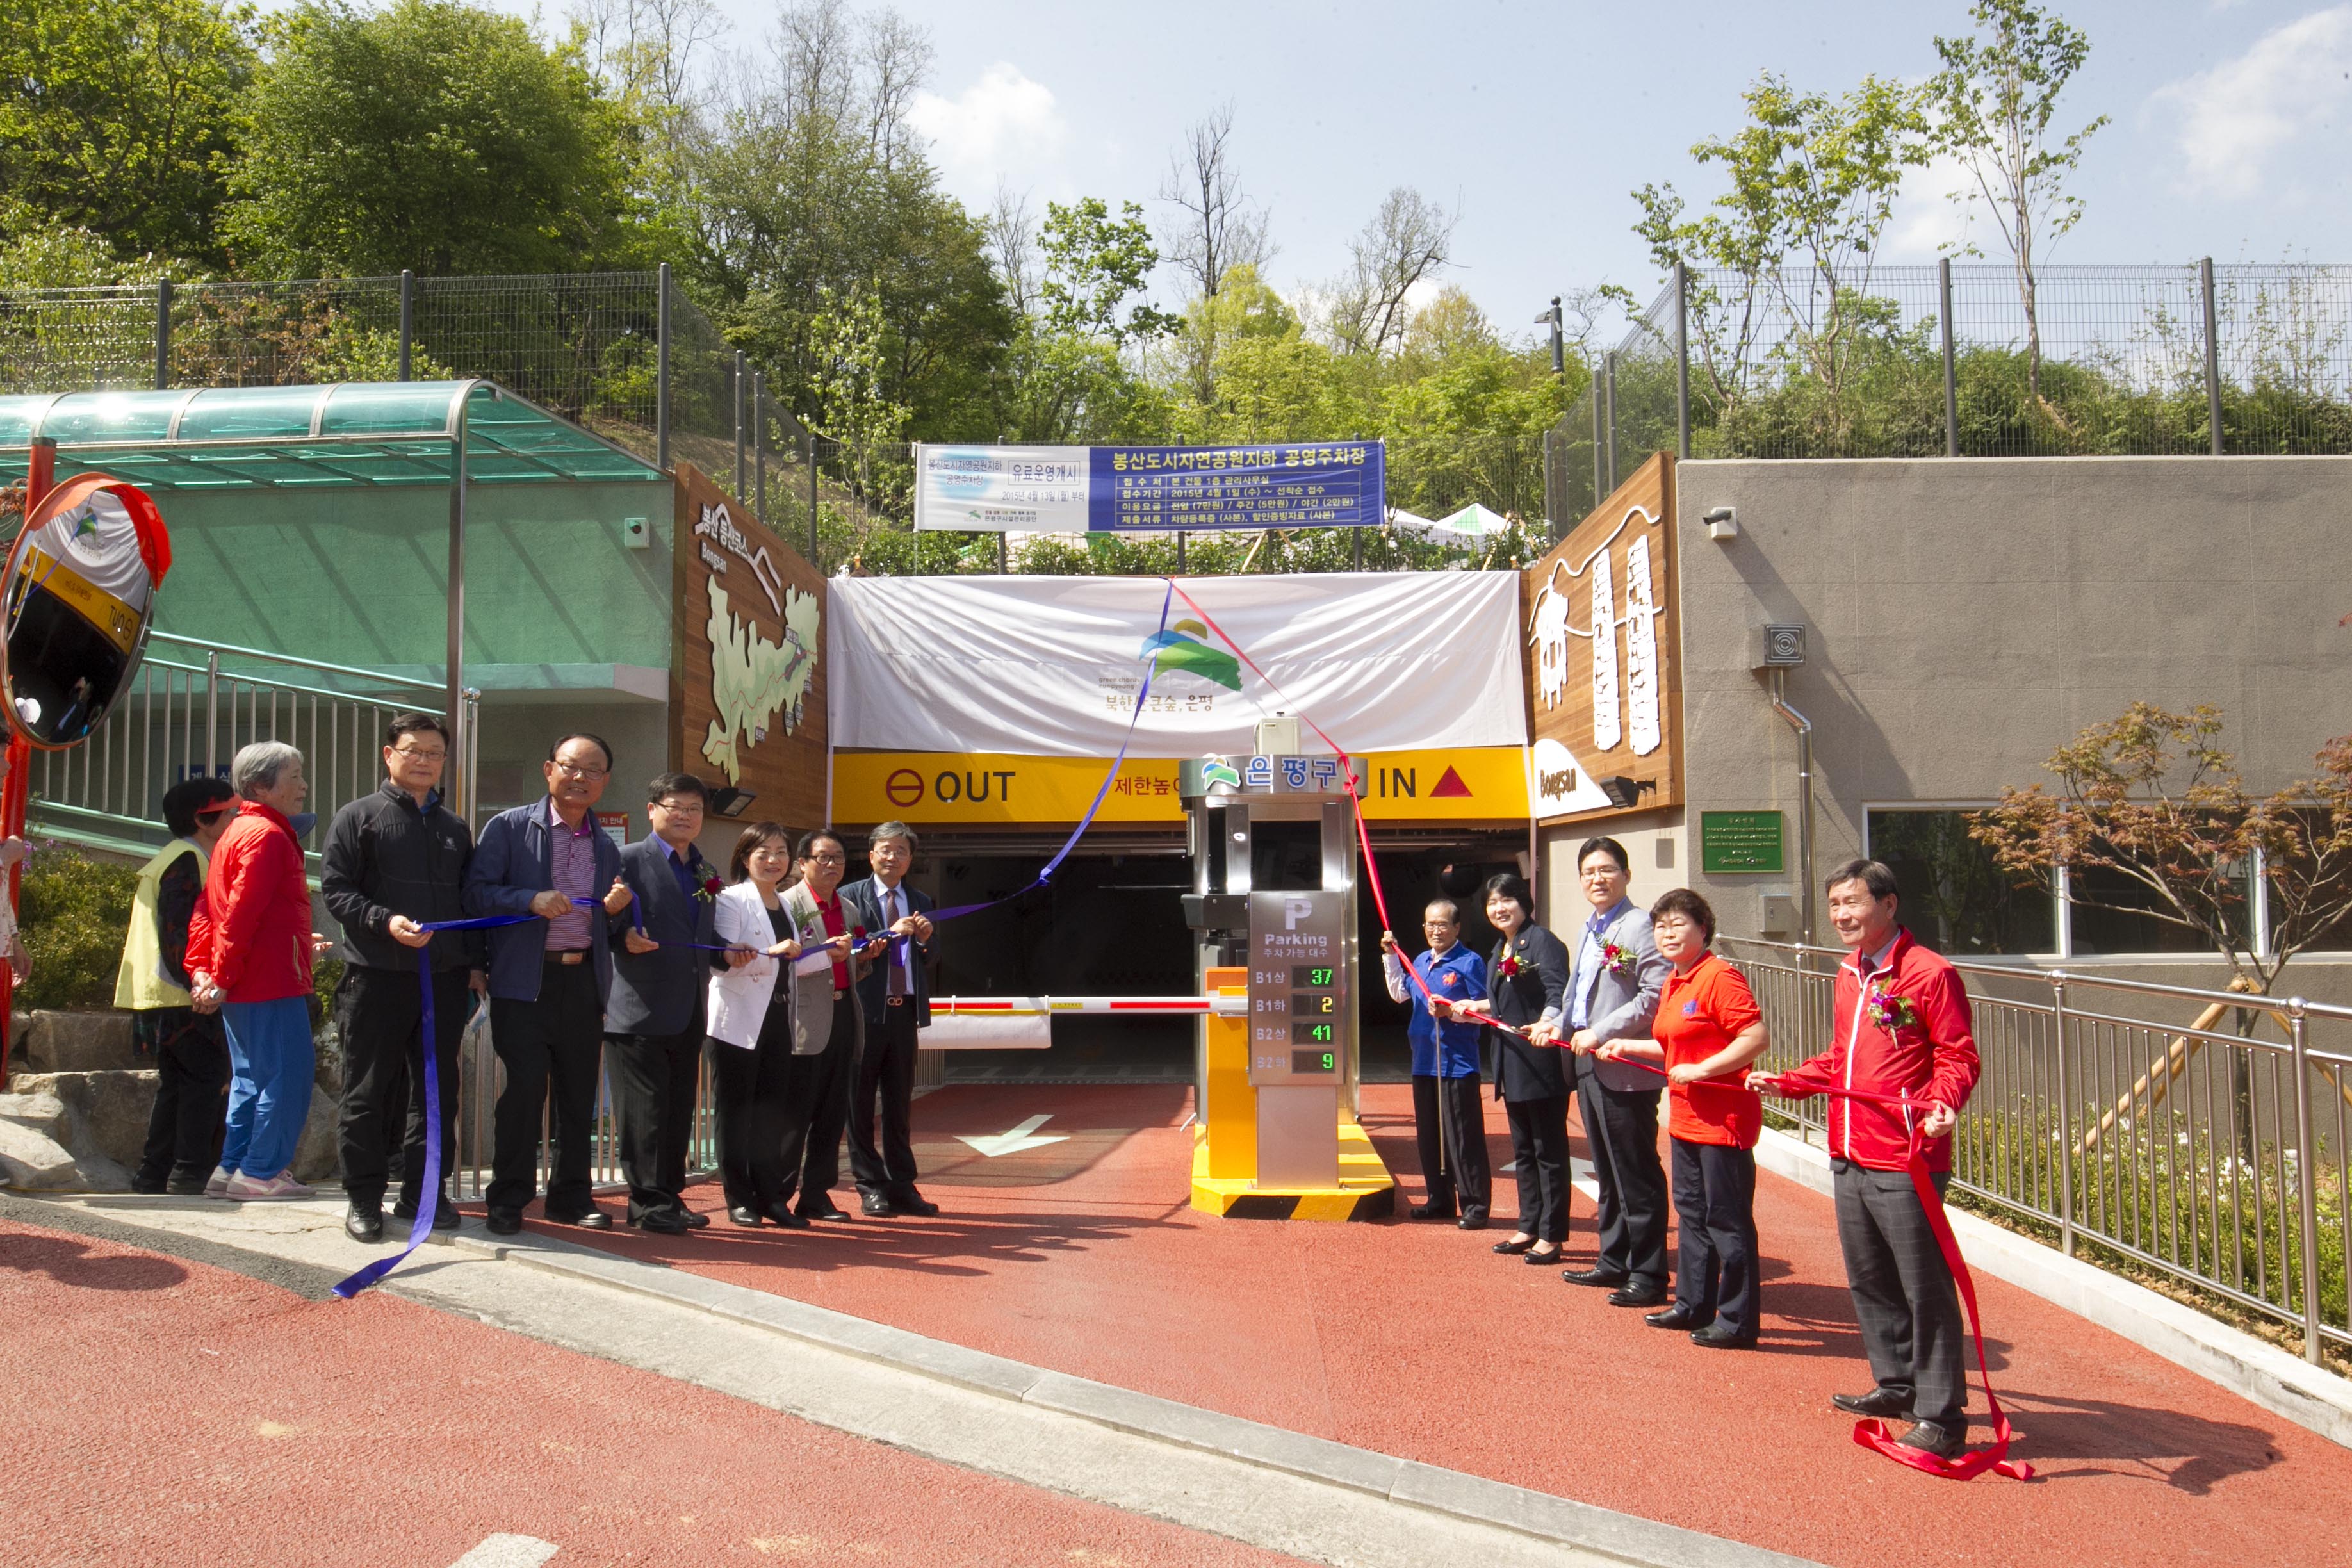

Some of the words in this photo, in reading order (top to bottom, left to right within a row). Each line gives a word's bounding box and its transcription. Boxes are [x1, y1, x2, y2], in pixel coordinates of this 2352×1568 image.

[928, 459, 1002, 471] 봉산도시자연공원지하
[1113, 450, 1277, 470] 봉산도시자연공원지하
[1285, 447, 1366, 467] 공영주차장
[947, 474, 983, 486] 공영주차장
[1013, 464, 1076, 482] 유료운영개시
[1171, 477, 1180, 486] 본
[1185, 477, 1202, 486] 건물
[1225, 475, 1269, 485] 관리사무실
[1002, 491, 1025, 502] 2015년
[1027, 491, 1038, 502] 4월
[1041, 491, 1055, 502] 13일
[1058, 491, 1069, 502] (월)
[1072, 491, 1084, 502] 부터
[1122, 489, 1161, 498] 접수기간
[1171, 489, 1203, 498] 2015년
[1207, 488, 1221, 498] 4월
[1227, 488, 1239, 496] 1일
[1244, 487, 1261, 496] (수)
[1277, 486, 1303, 495] 선착순
[1307, 486, 1325, 495] 접수
[1122, 502, 1161, 511] 이용요금
[1193, 501, 1224, 510] (7만원)
[1237, 500, 1254, 509] 주간
[1258, 499, 1289, 509] (5만원)
[1301, 498, 1319, 507] 야간
[1323, 497, 1353, 507] (2만원)
[702, 503, 719, 542] 봉산
[1122, 514, 1161, 524] 제출서류
[1171, 514, 1215, 523] 차량등록증
[1252, 512, 1306, 521] 할인증빙자료
[1309, 510, 1335, 519] (사본)
[701, 539, 728, 575] Bongsan
[1186, 694, 1213, 712] 은평
[1246, 756, 1337, 788] 은평구
[935, 771, 1016, 803] OUT
[1380, 768, 1416, 798] IN
[1540, 768, 1576, 802] Bongsan
[1285, 898, 1312, 930] P
[1264, 933, 1327, 947] Parking
[1264, 948, 1283, 958] 주차
[1286, 948, 1305, 958] 가능
[1309, 948, 1328, 958] 대수
[1312, 968, 1332, 984] 37
[1321, 997, 1332, 1013] 2
[1312, 1025, 1330, 1041] 41
[1322, 1053, 1334, 1069] 9
